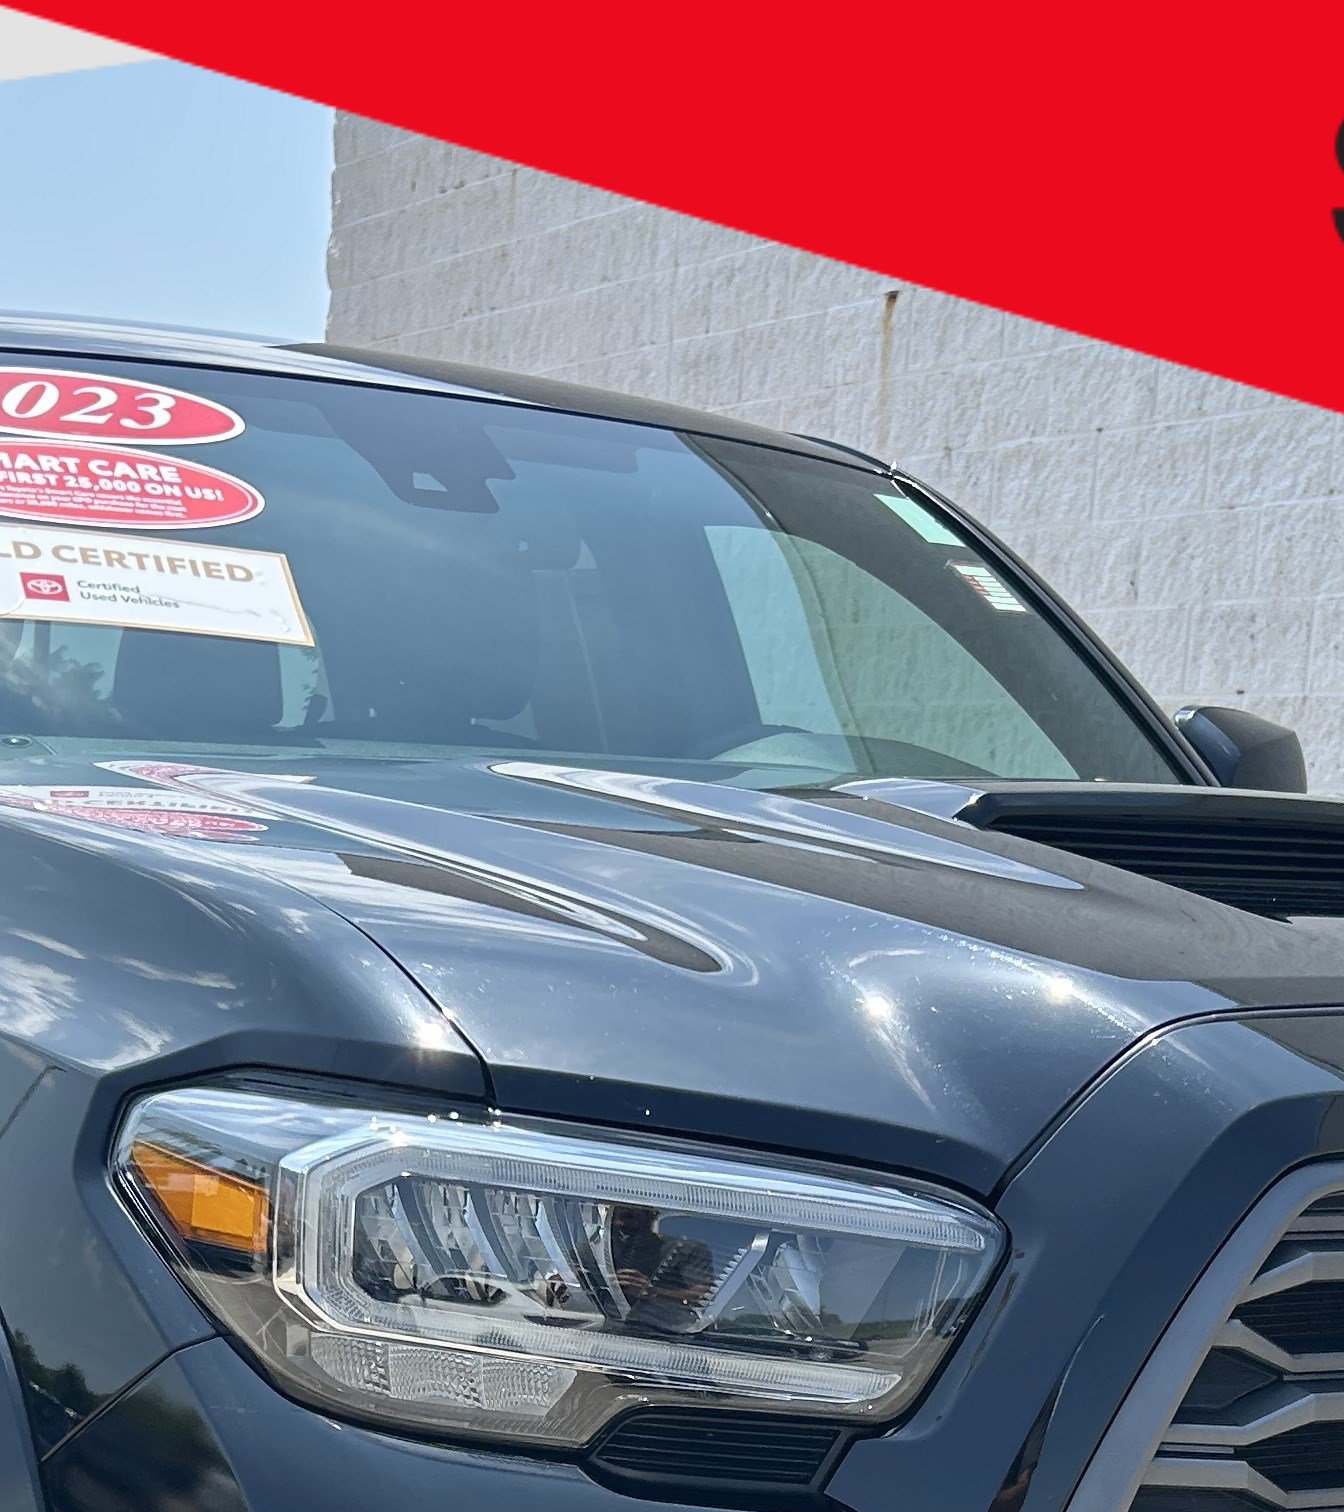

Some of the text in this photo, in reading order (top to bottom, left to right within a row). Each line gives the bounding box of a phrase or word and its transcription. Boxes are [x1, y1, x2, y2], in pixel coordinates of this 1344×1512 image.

[88, 459, 182, 484] CARE
[63, 475, 142, 491] 25,000
[144, 482, 182, 497] ON
[184, 485, 224, 501] US!
[51, 544, 254, 582] CERTIFIED
[77, 580, 141, 594] Certified
[80, 591, 181, 609] Used Vehicles
